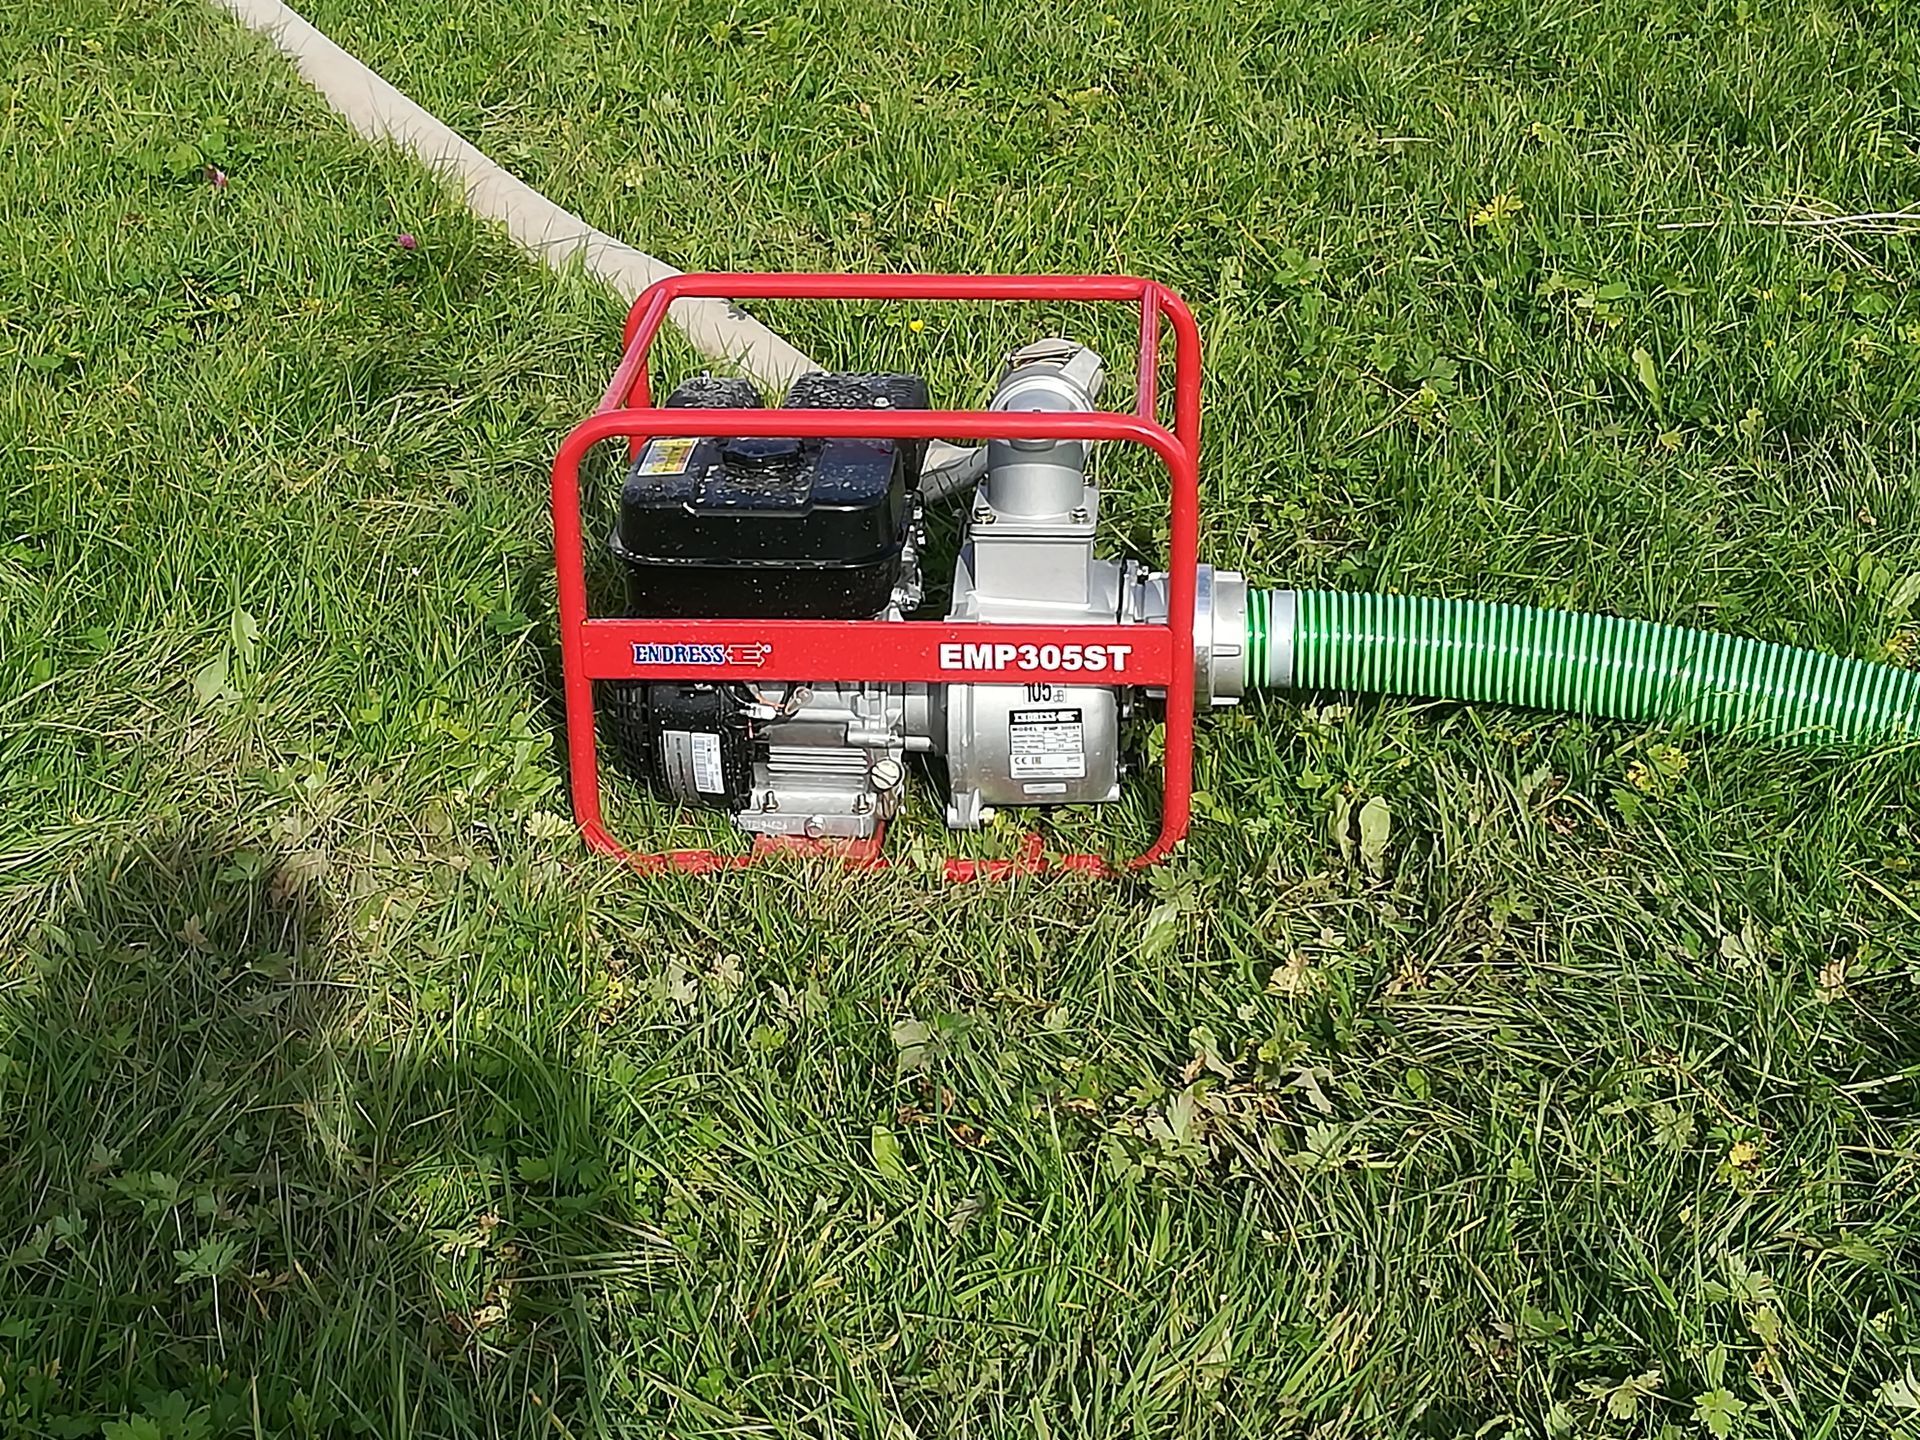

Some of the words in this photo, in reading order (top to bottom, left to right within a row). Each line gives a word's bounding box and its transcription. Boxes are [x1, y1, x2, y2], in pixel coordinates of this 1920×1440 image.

[633, 644, 724, 664] ENDRESS
[939, 643, 1132, 671] EMP305ST
[1024, 683, 1051, 702] 105
